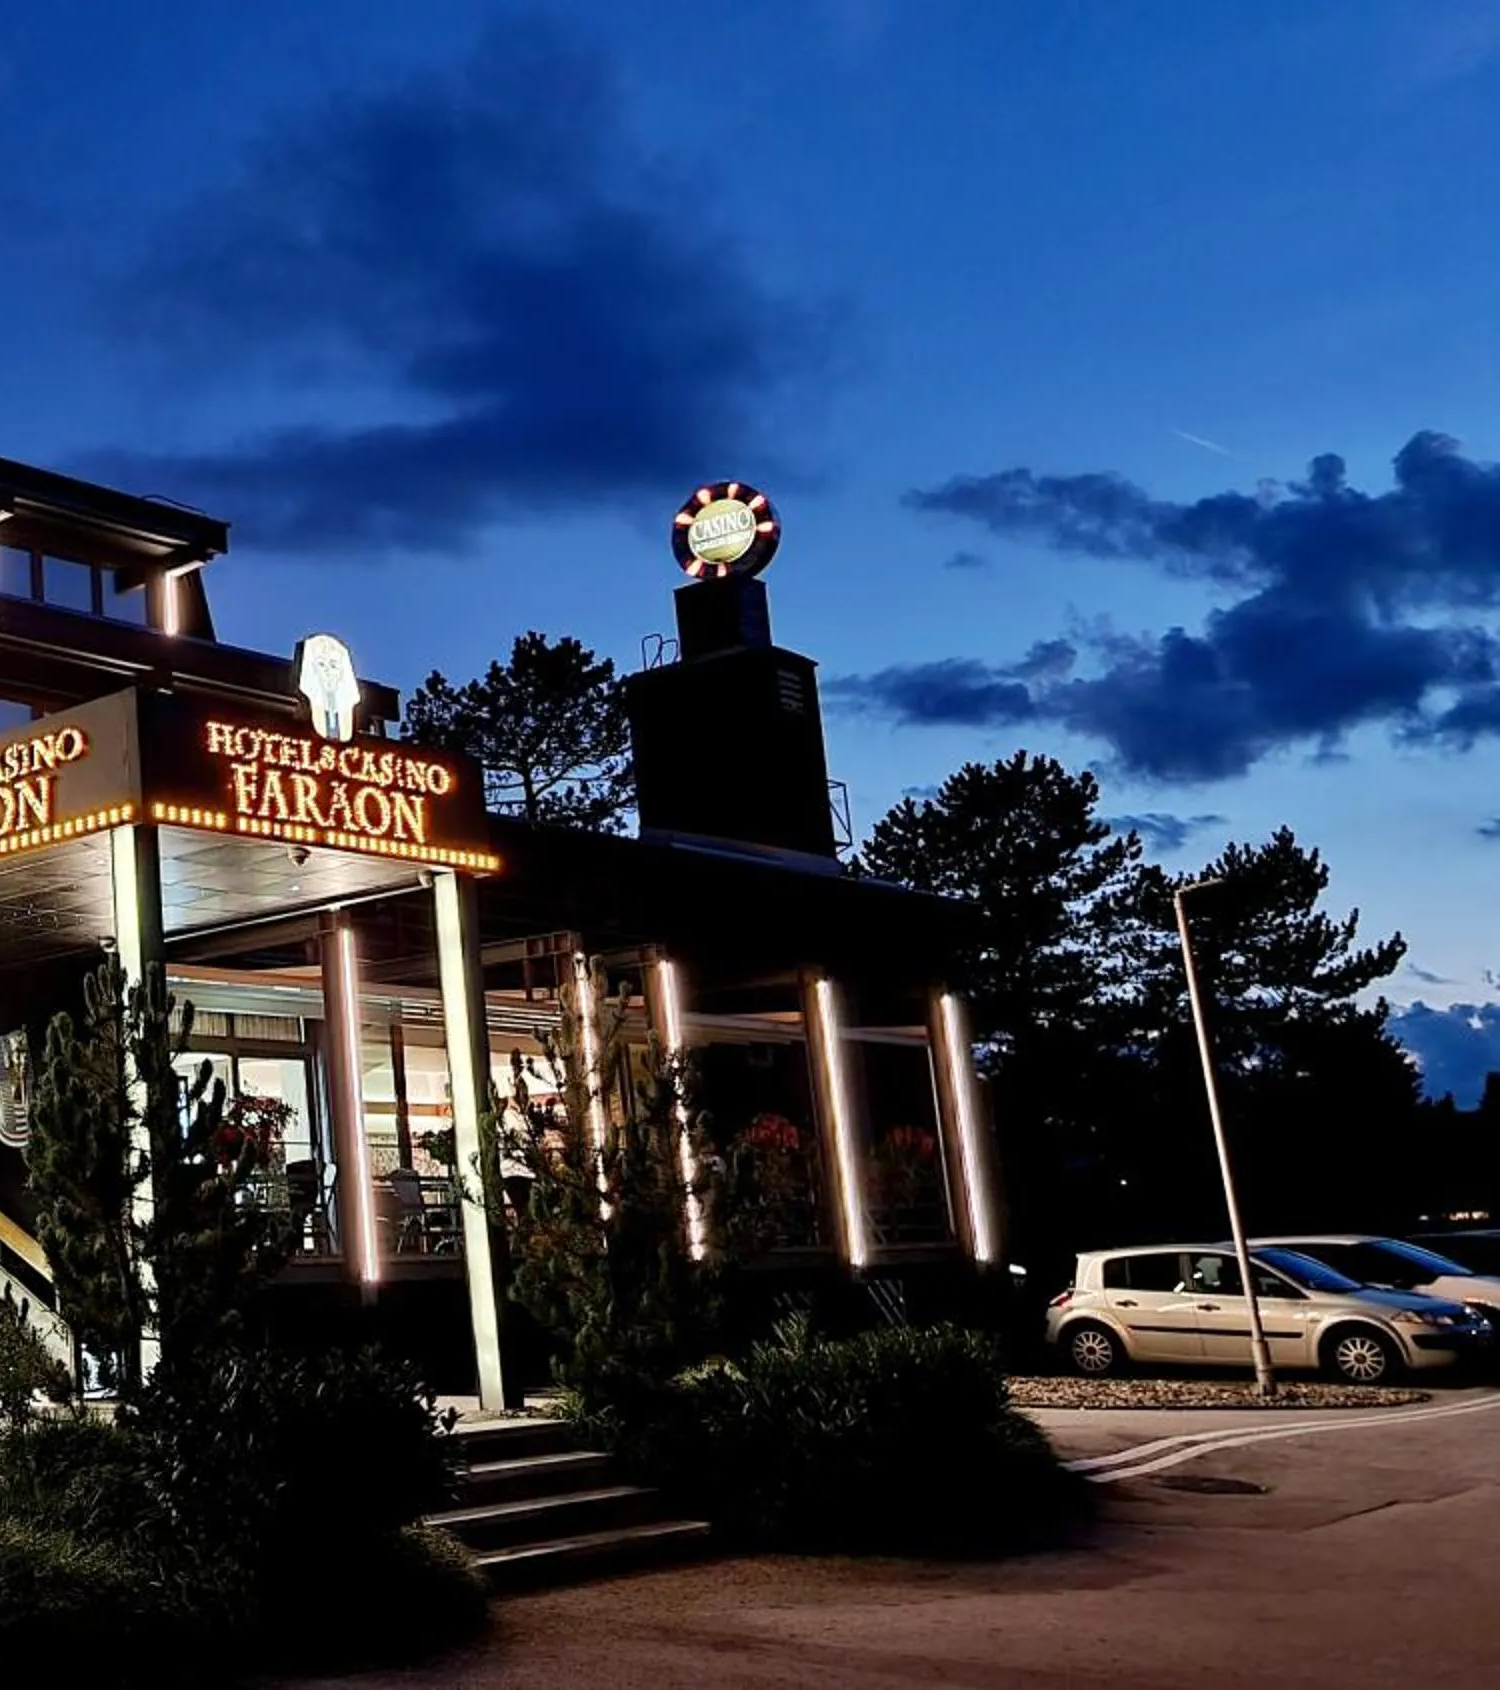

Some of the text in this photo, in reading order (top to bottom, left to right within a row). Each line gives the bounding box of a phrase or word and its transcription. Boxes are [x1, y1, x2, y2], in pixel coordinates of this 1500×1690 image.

[691, 509, 751, 541] CASINO
[206, 721, 320, 774] HOTEL
[338, 747, 452, 796] CASINO
[230, 762, 426, 844] FARAON
